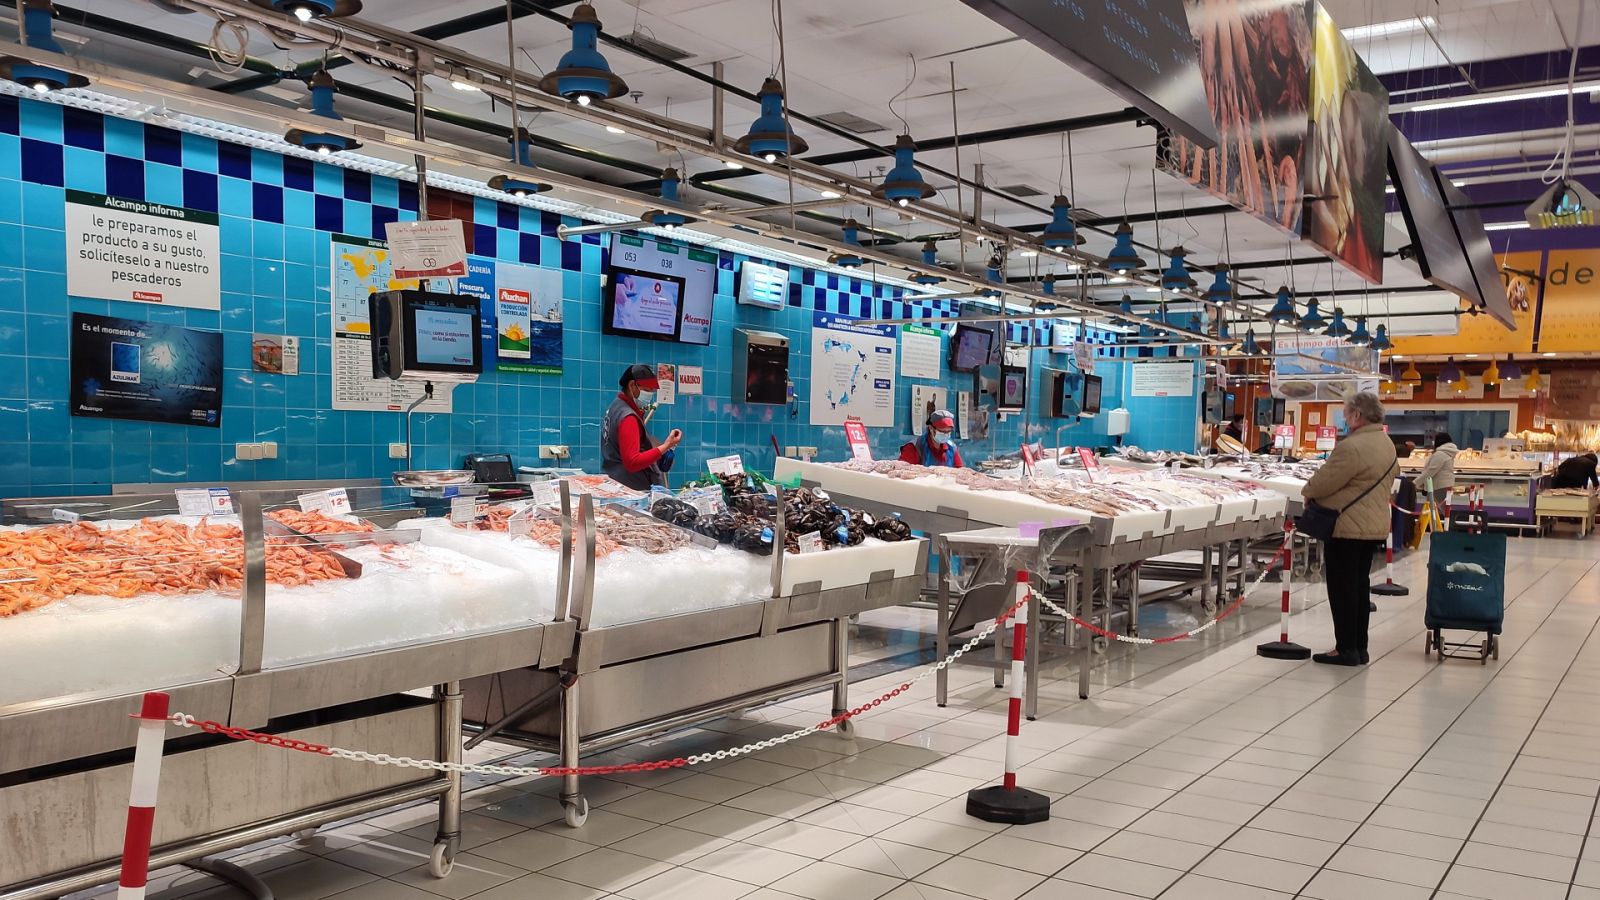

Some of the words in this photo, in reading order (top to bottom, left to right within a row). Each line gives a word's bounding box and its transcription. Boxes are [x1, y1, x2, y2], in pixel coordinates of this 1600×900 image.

[105, 196, 147, 212] Alcampo
[149, 203, 184, 218] informa
[92, 214, 104, 227] le
[108, 218, 182, 238] preparamos
[186, 230, 197, 241] el
[82, 232, 138, 249] producto
[142, 241, 148, 250] a
[153, 242, 167, 253] su
[171, 246, 206, 258] gusto.
[80, 248, 150, 267] solicíteselo
[154, 259, 161, 268] a
[165, 260, 209, 274] nuestro
[624, 252, 637, 262] 053
[661, 259, 672, 268] 038
[469, 265, 491, 274] CADERÍA
[1550, 262, 1594, 285] de
[112, 270, 182, 286] pescaderos
[459, 282, 484, 292] Frescura
[459, 291, 490, 300] urada
[501, 291, 528, 303] Auchan
[684, 314, 709, 325] Alcampo
[82, 323, 91, 331] Es
[102, 327, 135, 337] momento
[1292, 341, 1322, 349] tiempo
[680, 374, 700, 384] MARISCO
